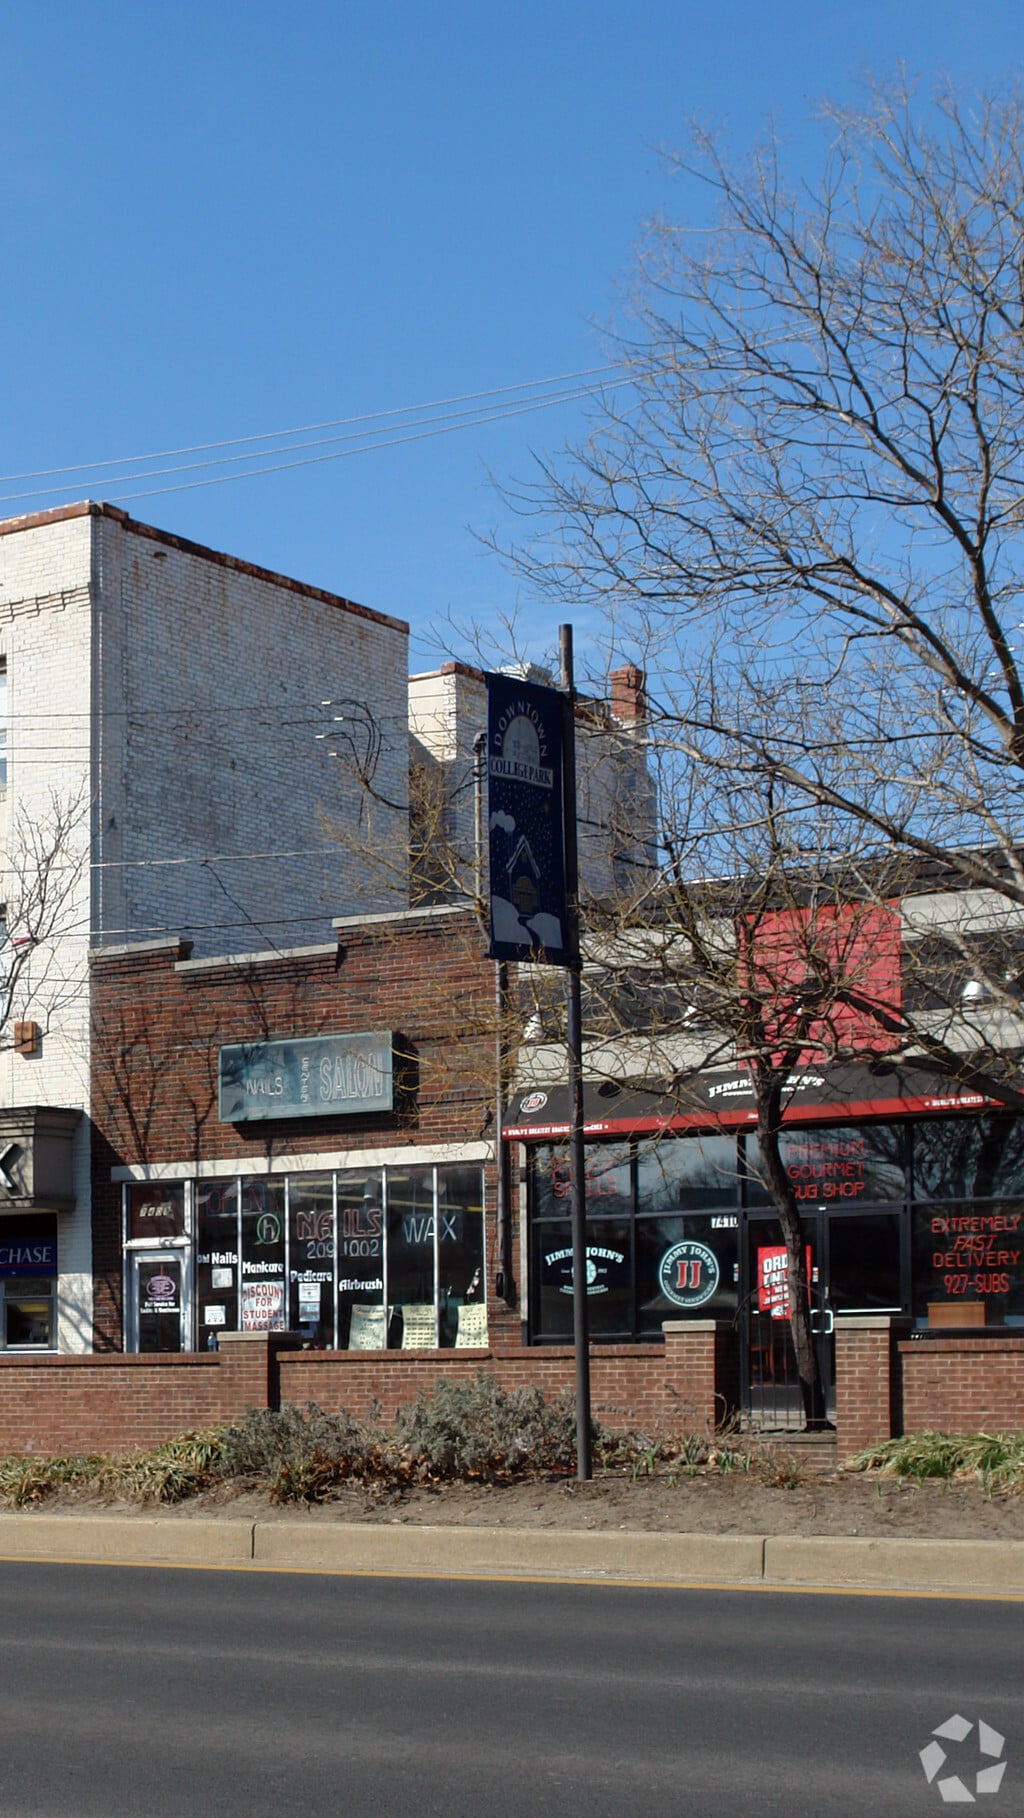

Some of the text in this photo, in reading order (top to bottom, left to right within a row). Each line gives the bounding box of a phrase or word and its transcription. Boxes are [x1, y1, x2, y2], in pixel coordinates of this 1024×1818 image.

[494, 700, 547, 757] DOWNTOWN
[491, 758, 552, 785] COLLEGE PARK
[246, 1053, 384, 1103] NAILS CENTER SALON
[787, 1140, 865, 1160] PREMIUM
[787, 1161, 865, 1180] GOURMET
[822, 1181, 865, 1199] SHOP
[296, 1209, 382, 1241] NAILS
[403, 1215, 457, 1243] WAX
[931, 1215, 1022, 1233] EXTREMELY
[953, 1234, 998, 1251] FAST
[211, 1251, 238, 1265] Nails
[545, 1246, 625, 1266] JIMM JOHN'S
[663, 1246, 716, 1275] JIMMY JOHN'S
[932, 1250, 1021, 1268] DELIVERY
[242, 1260, 284, 1275] Manicure
[290, 1270, 333, 1283] Pedicure
[676, 1260, 703, 1288] JJ
[339, 1278, 383, 1292] Airbrush
[943, 1273, 1010, 1294] 927-SUBS
[255, 1298, 273, 1307] FOR
[243, 1310, 284, 1320] STUDENT
[244, 1321, 285, 1331] MASSAGE
